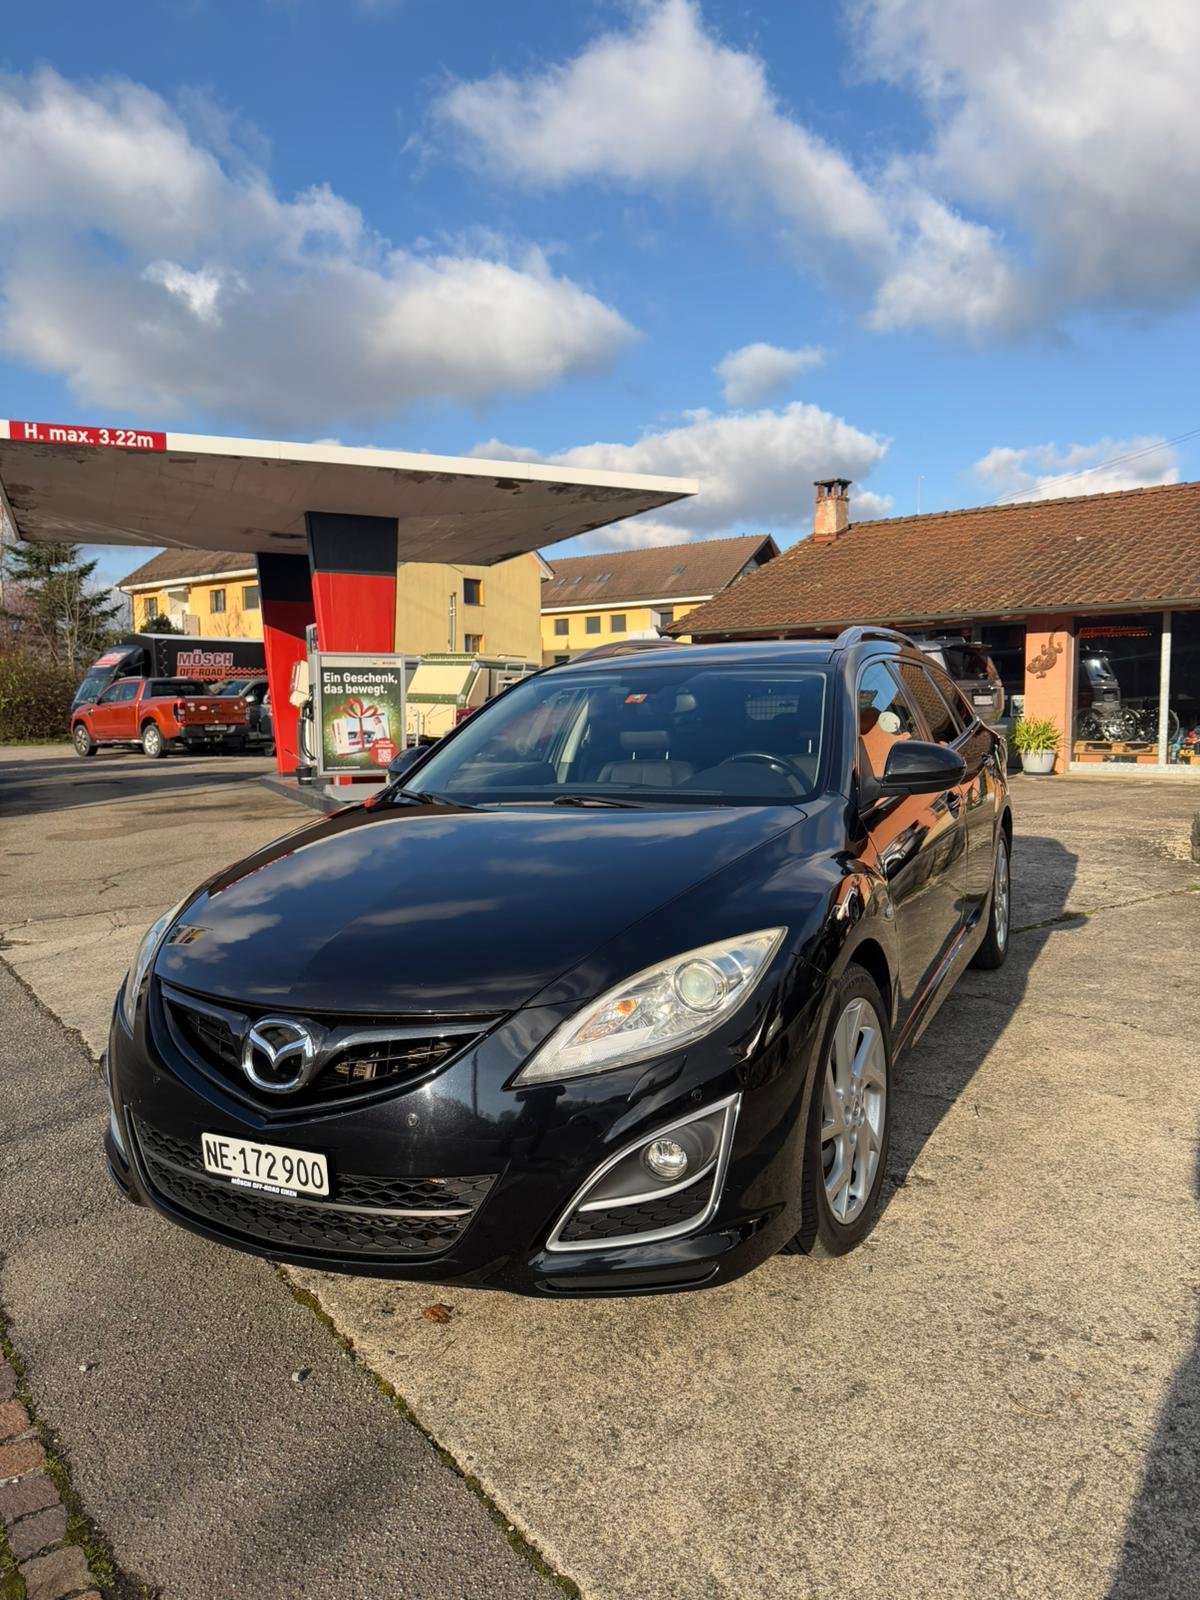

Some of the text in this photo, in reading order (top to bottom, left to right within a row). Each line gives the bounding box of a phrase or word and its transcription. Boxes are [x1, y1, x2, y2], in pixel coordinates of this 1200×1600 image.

[24, 423, 154, 448] H. max. 3.22m
[177, 649, 234, 666] MÖSCH
[179, 667, 223, 677] OFF-ROAD
[323, 672, 398, 684] Ein Geschenk,
[323, 684, 388, 696] das bewegt.
